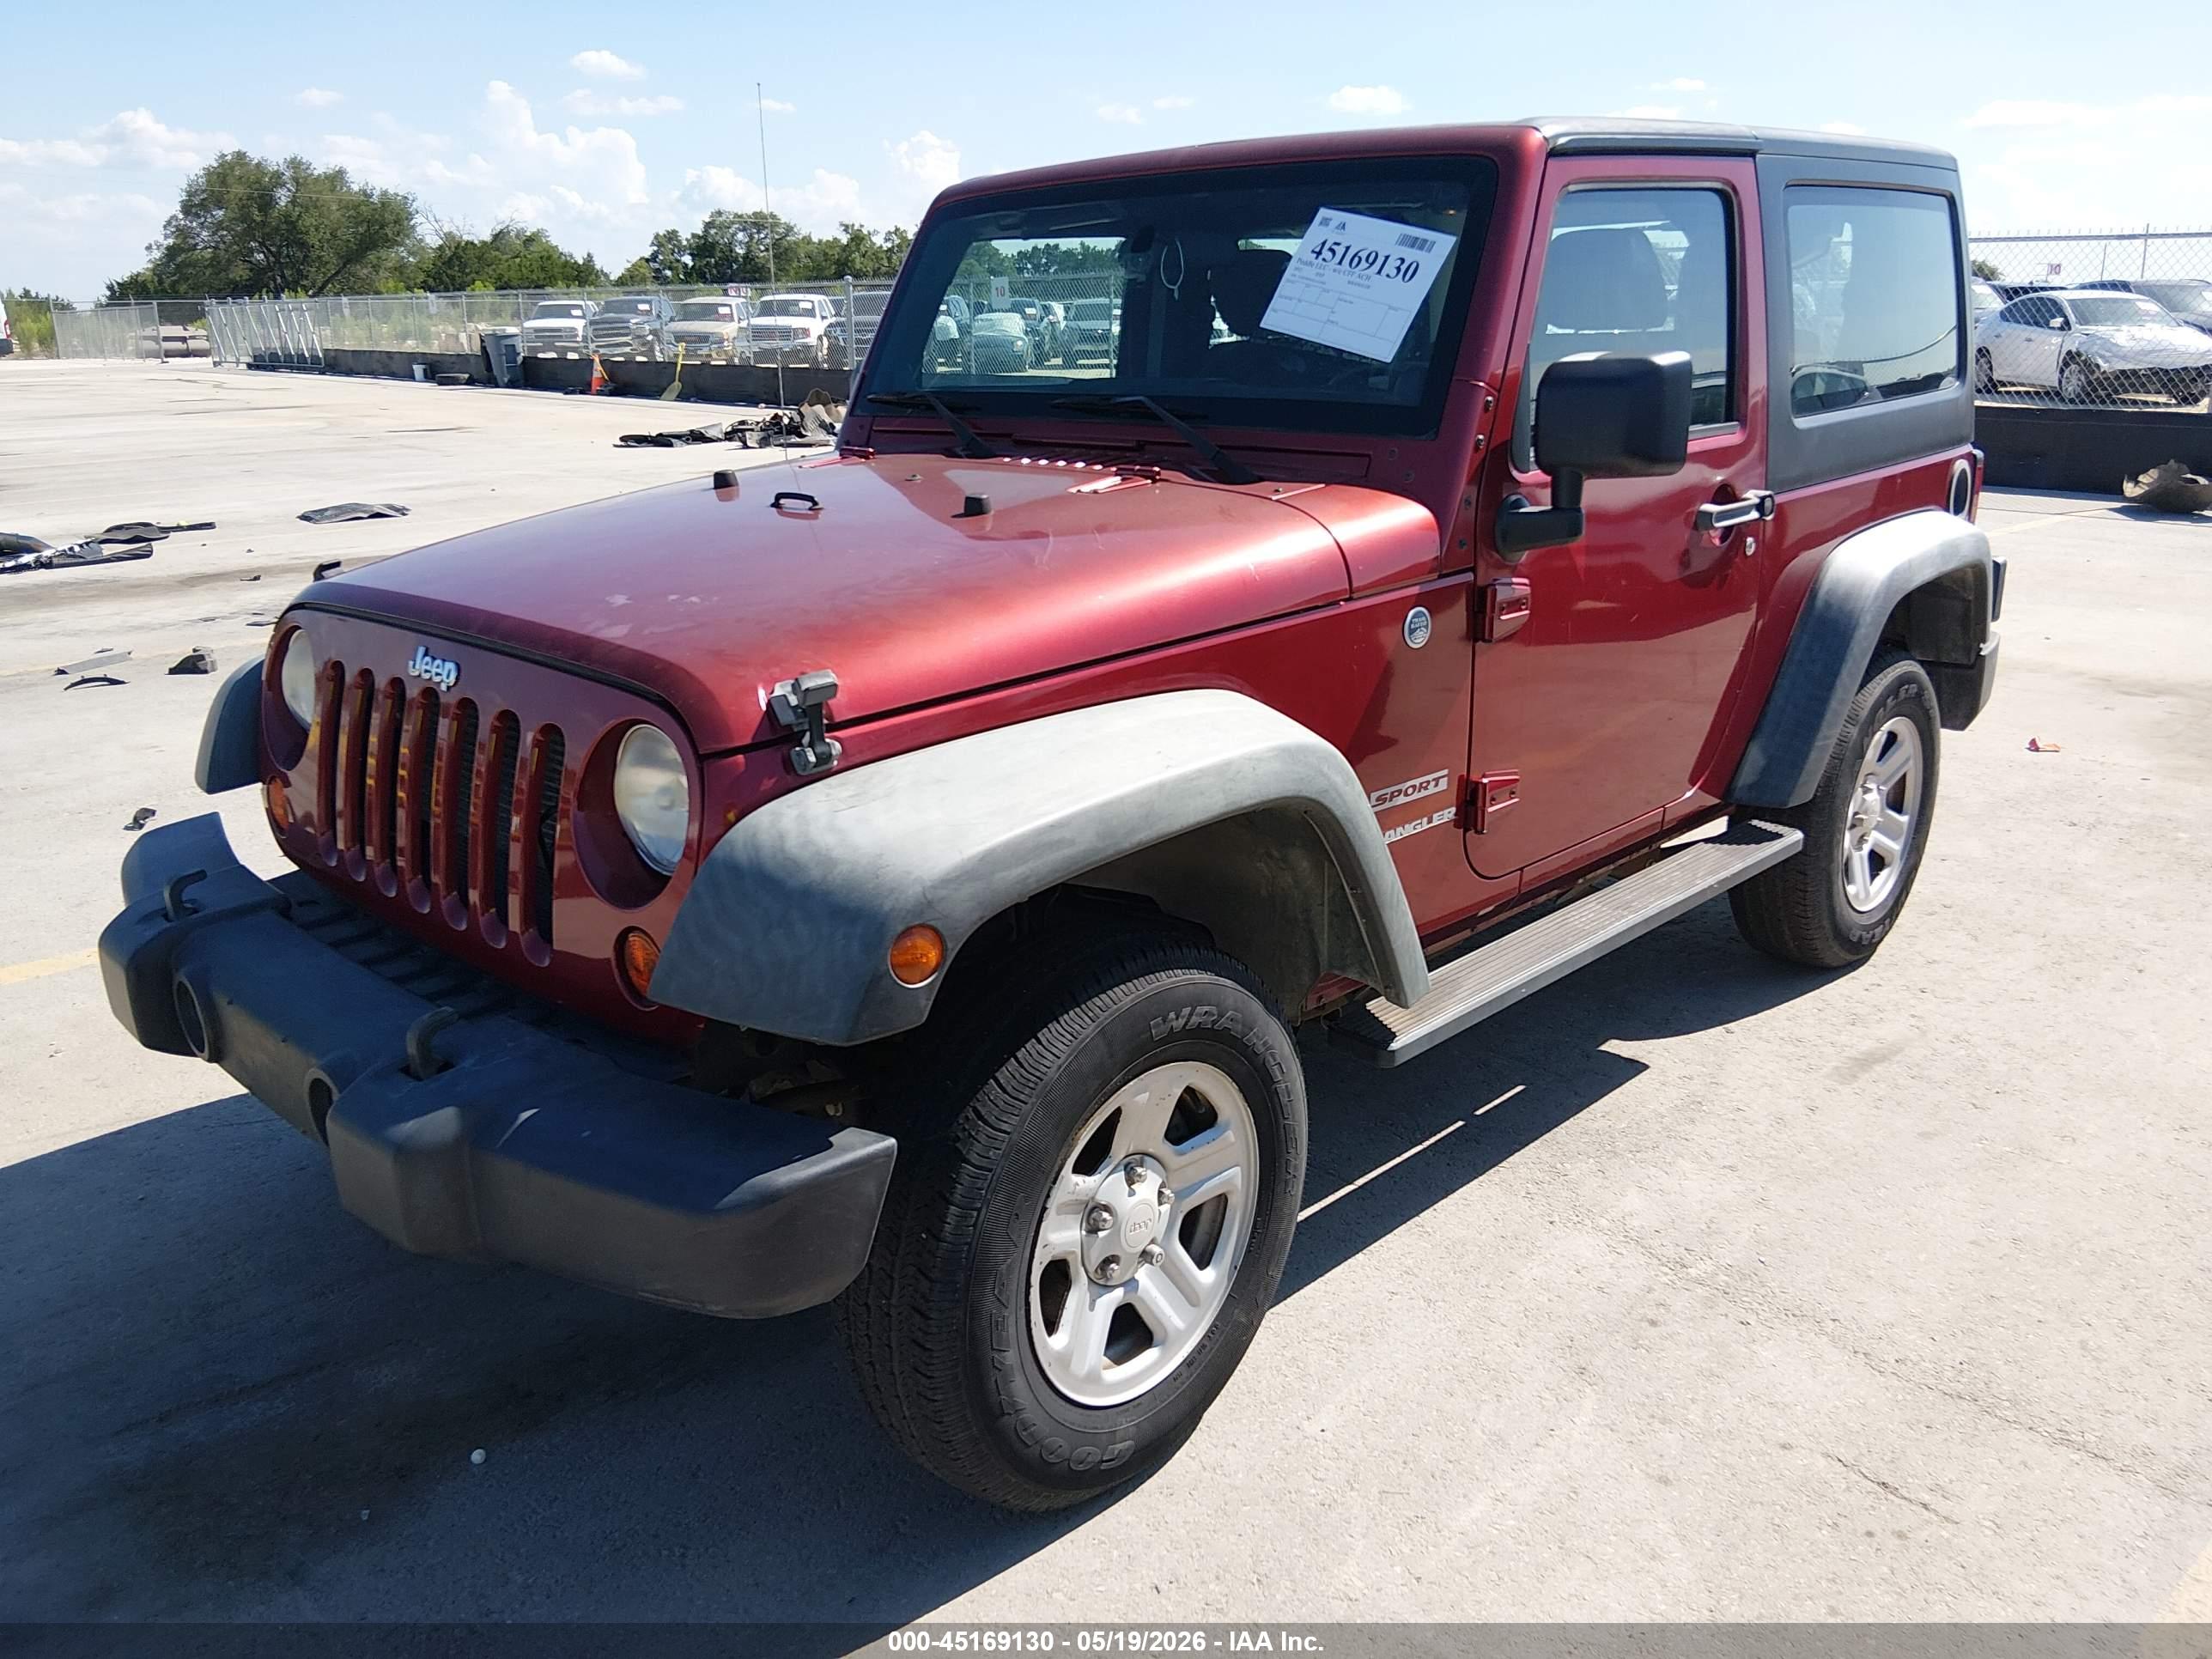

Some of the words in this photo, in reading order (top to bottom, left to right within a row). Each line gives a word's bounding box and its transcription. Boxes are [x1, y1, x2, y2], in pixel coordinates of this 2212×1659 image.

[1310, 239, 1419, 283] 45169130
[995, 285, 1006, 297] 10
[408, 646, 459, 693] Jeep
[1371, 773, 1449, 809] SPORT
[1382, 807, 1458, 843] ANGLER
[1149, 1006, 1300, 1197] WRANGLER
[992, 1194, 1136, 1471] GOODYEAR
